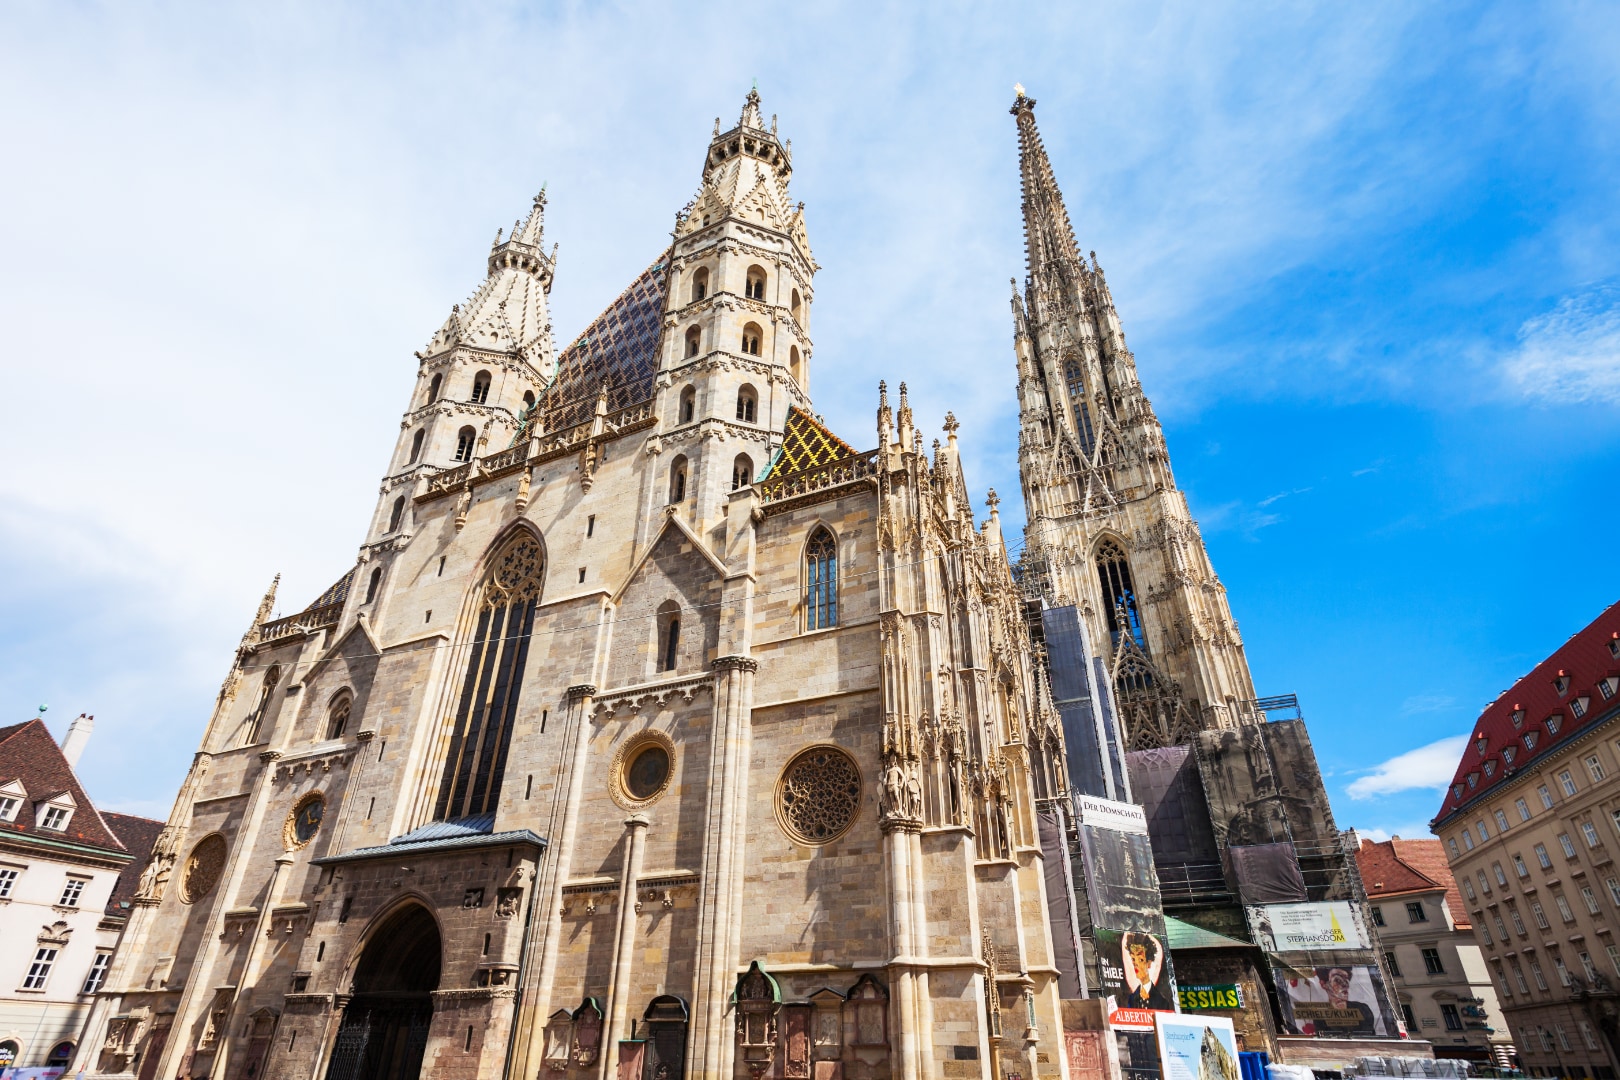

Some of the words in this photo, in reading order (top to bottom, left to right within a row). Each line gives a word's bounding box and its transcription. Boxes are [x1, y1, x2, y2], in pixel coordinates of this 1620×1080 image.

[1083, 801, 1099, 811] DER
[1099, 804, 1142, 820] DOMSCHATZ
[1286, 934, 1345, 943] STEPHANSDOM
[1178, 989, 1238, 1009] ESSIAS
[1115, 1011, 1154, 1024] ALBERTIN
[1295, 1009, 1359, 1019] SCHIELE/KLIMT
